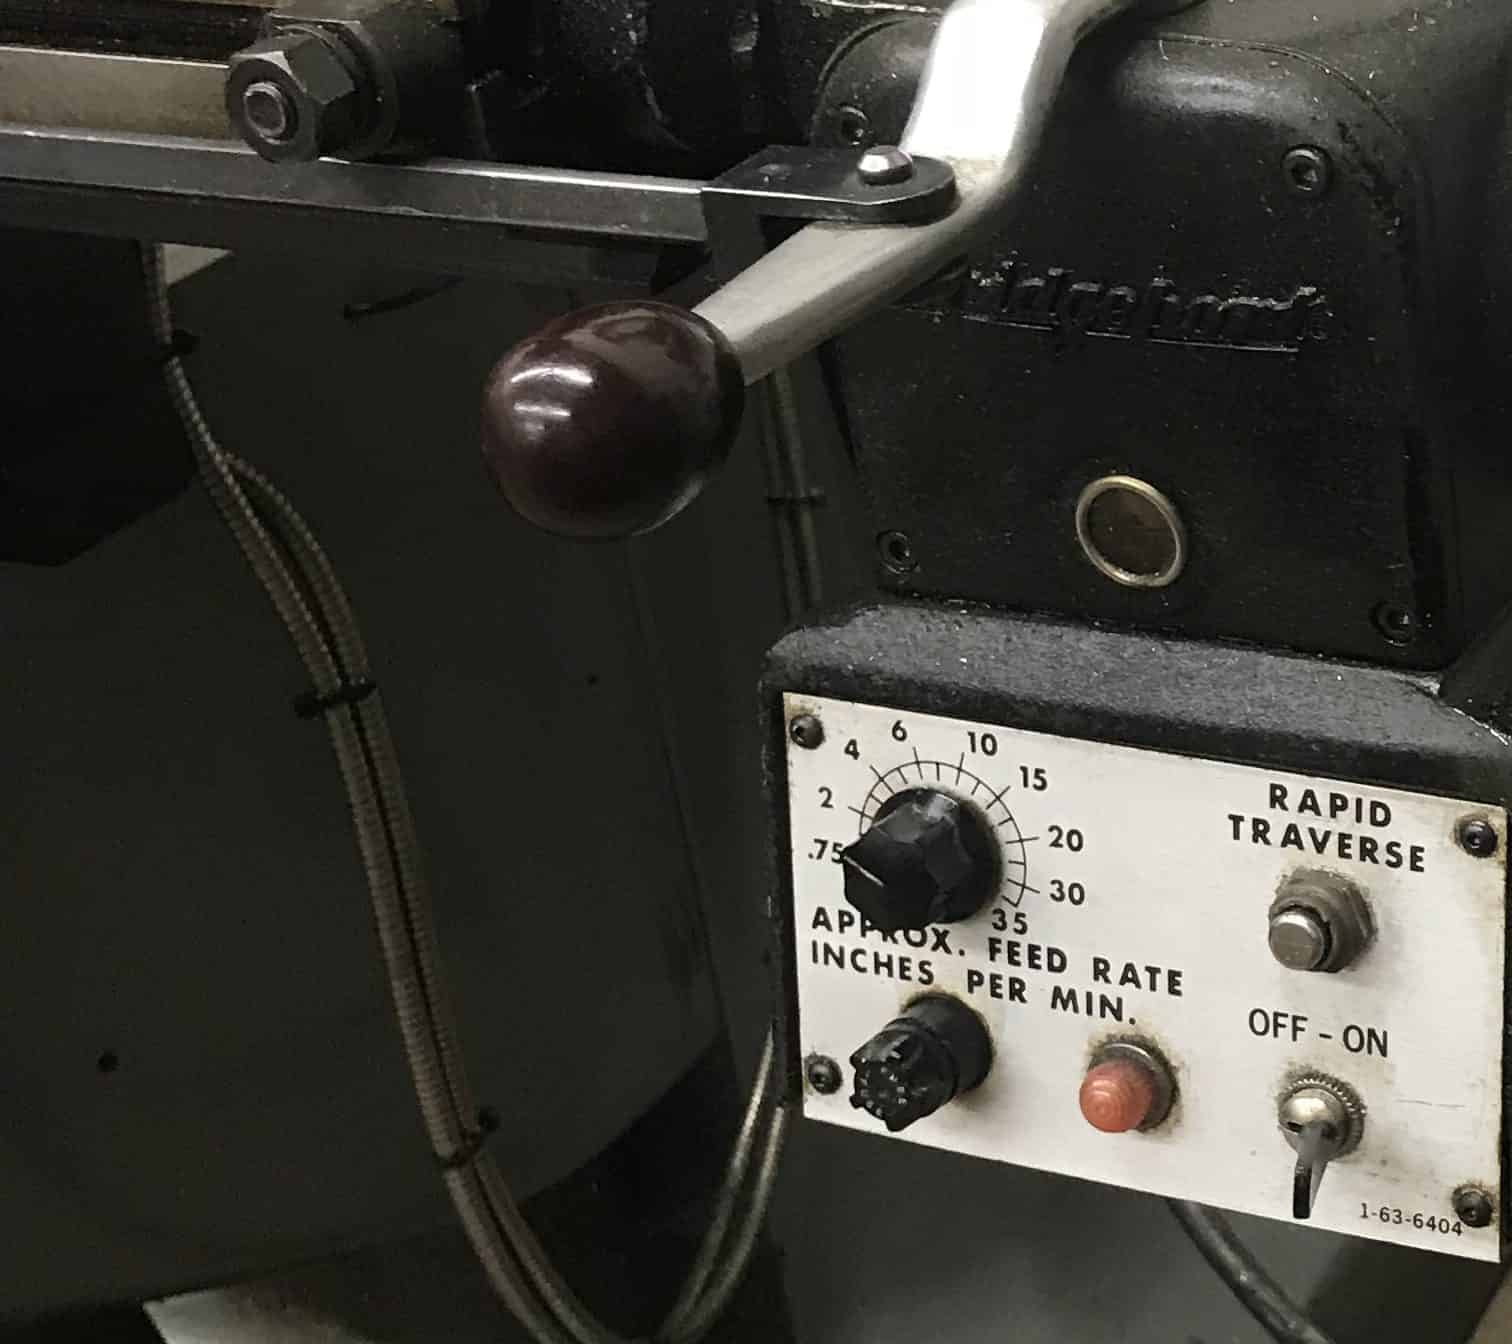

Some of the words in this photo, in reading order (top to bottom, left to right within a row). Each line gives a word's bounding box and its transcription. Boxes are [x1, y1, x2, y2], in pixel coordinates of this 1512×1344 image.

[891, 720, 909, 742] 6
[967, 731, 999, 757] 10
[843, 739, 861, 761] 4
[1019, 765, 1049, 792] 15
[817, 786, 835, 809] 2
[1268, 782, 1393, 828] RAPID
[807, 838, 844, 866] .75
[1047, 824, 1085, 853] 20
[1227, 813, 1426, 873] TRAVERSE
[1048, 879, 1086, 907] 30
[990, 908, 1029, 936] 35
[987, 937, 1069, 974] FEED
[1091, 956, 1184, 997] RATE
[810, 939, 935, 986] INCHES
[966, 968, 1028, 1004] PER
[1050, 985, 1137, 1025] MIN.
[1359, 1201, 1464, 1238] 1-63-6404
